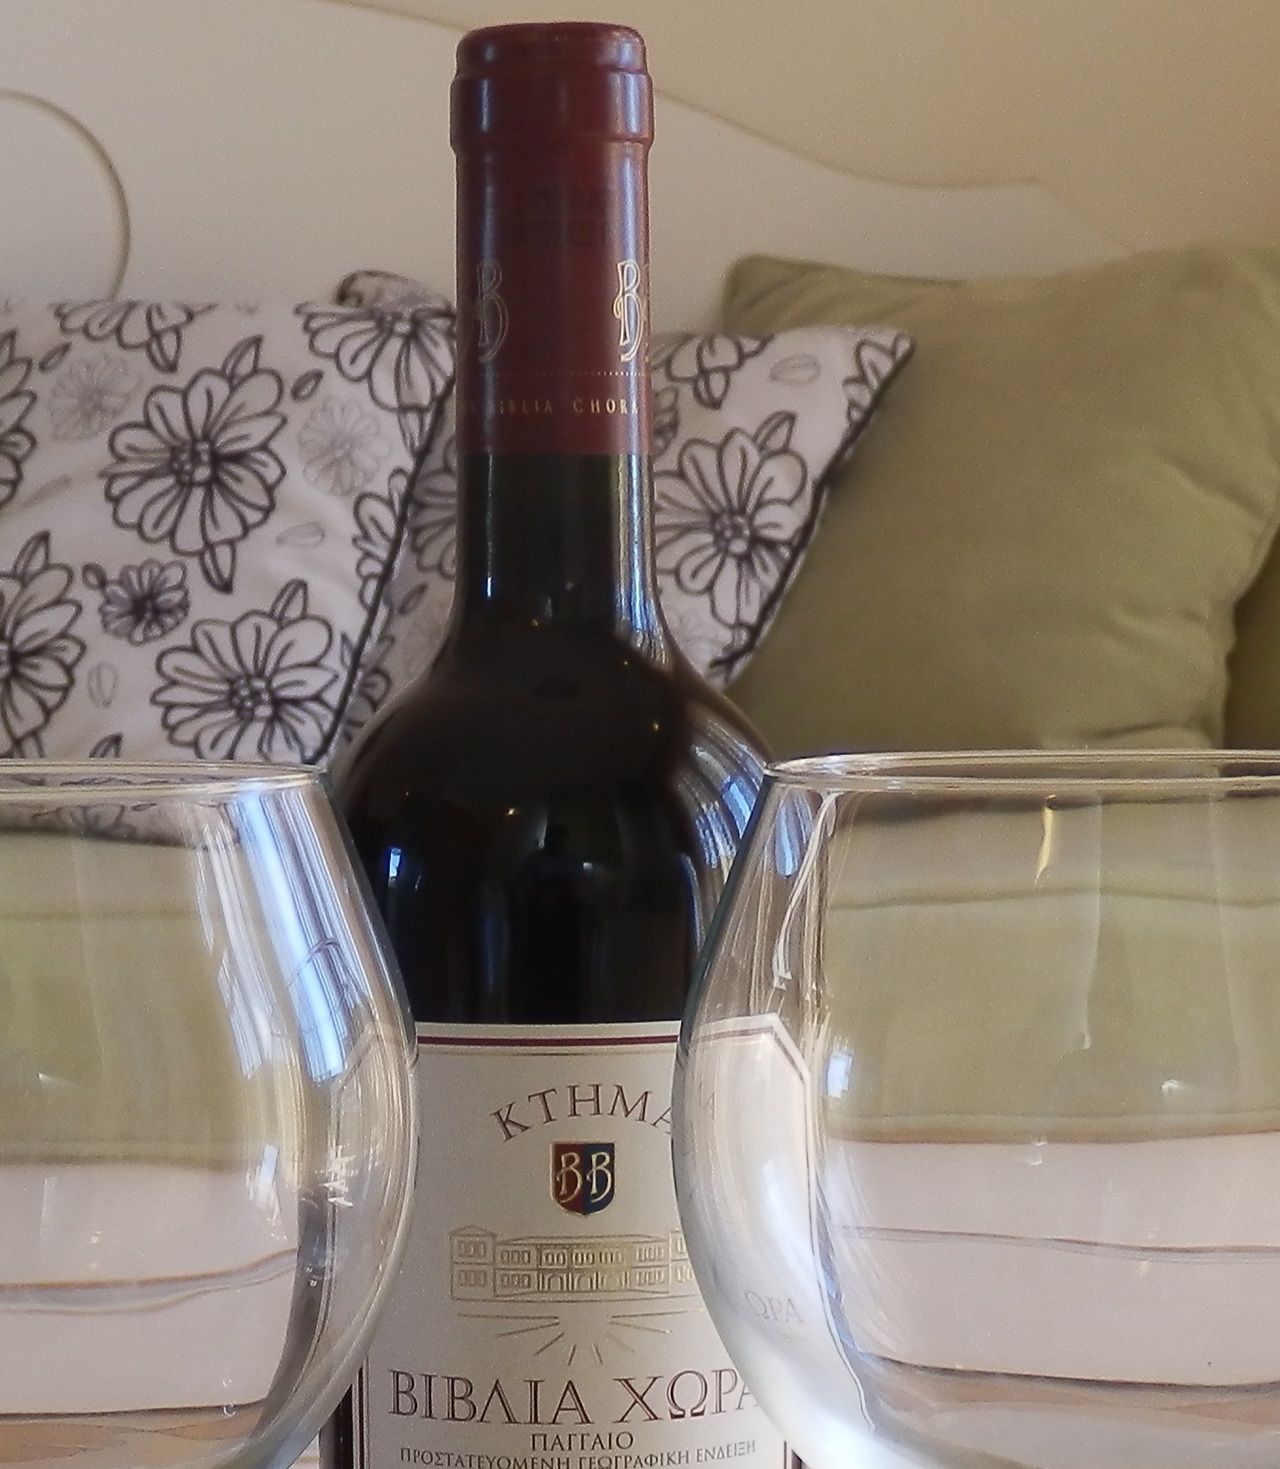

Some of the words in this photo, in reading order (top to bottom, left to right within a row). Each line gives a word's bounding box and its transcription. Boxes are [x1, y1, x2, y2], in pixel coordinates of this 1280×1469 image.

[388, 1369, 595, 1425] ΒΙΒΛΙΑ
[531, 1431, 634, 1451] ΠΑΓΓΑΙΟ
[696, 1440, 756, 1463] ΕΝΔΕΙΞΗ
